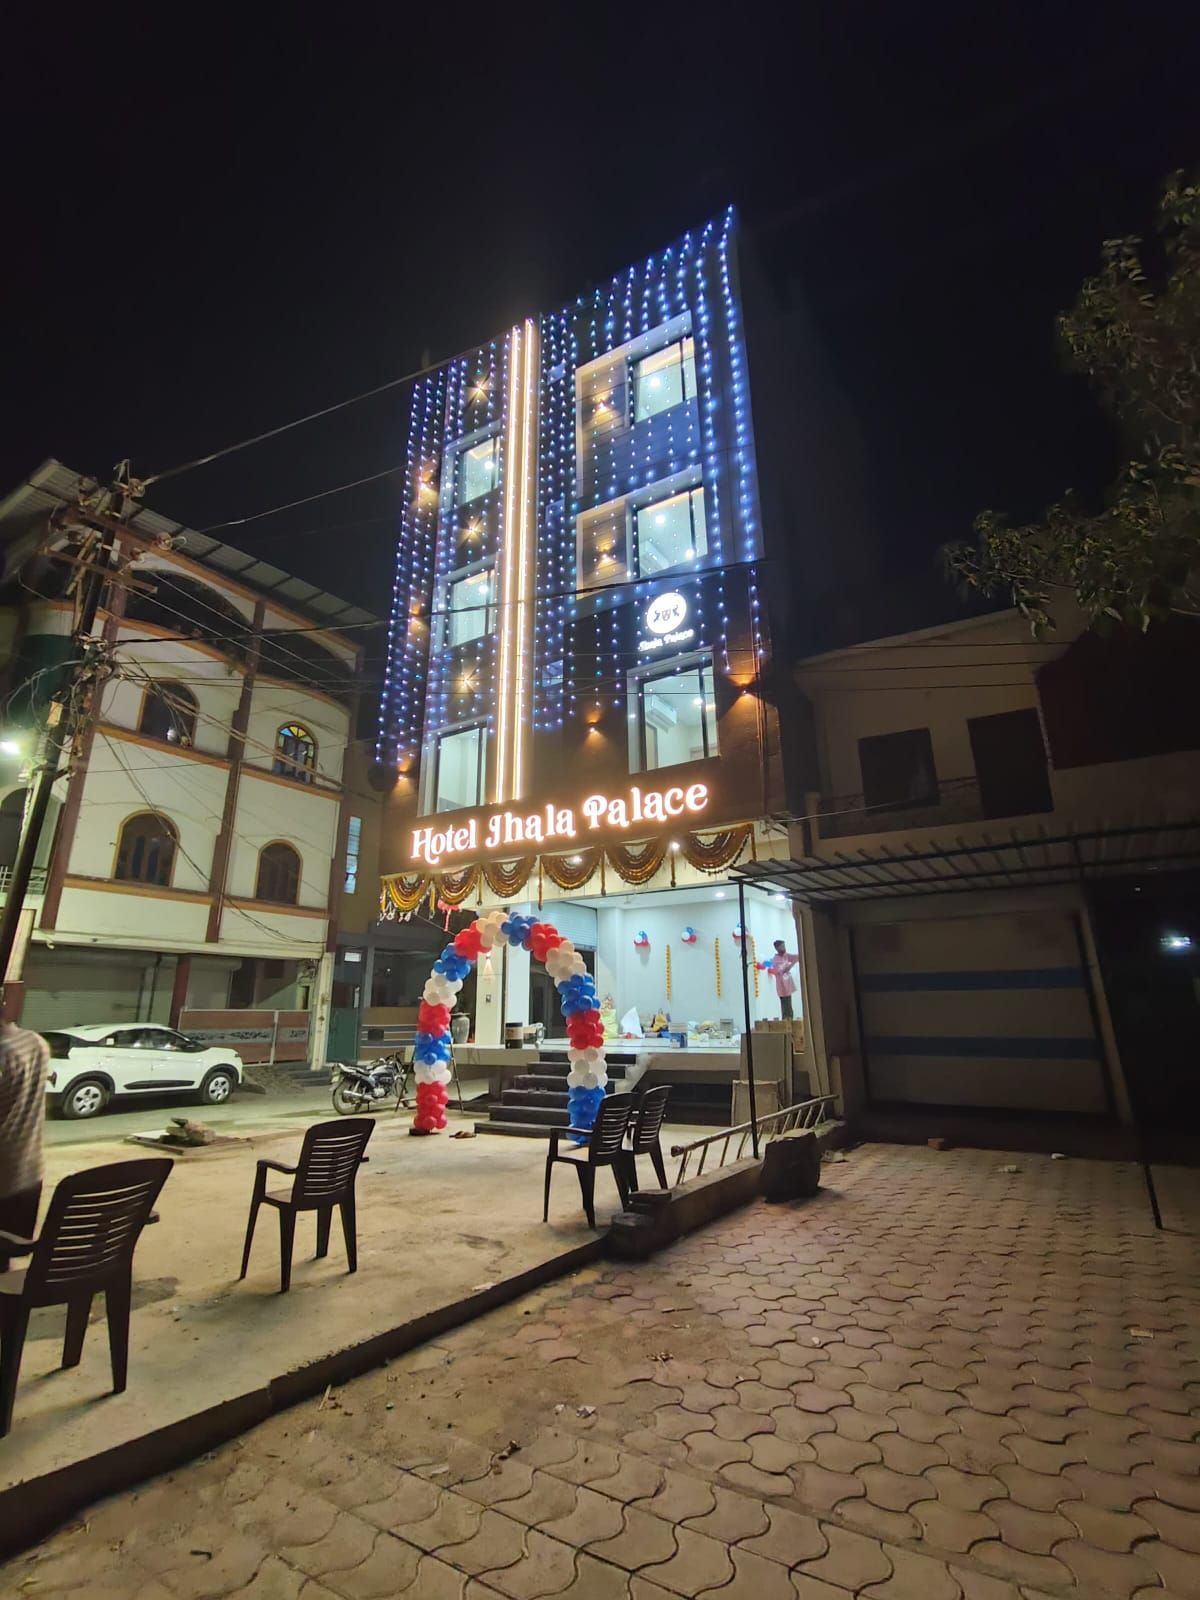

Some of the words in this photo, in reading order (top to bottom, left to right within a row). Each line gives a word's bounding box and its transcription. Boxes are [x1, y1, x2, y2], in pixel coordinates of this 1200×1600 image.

[411, 820, 476, 864] Hotel
[486, 805, 576, 847] Jhala
[584, 783, 708, 829] Palace
